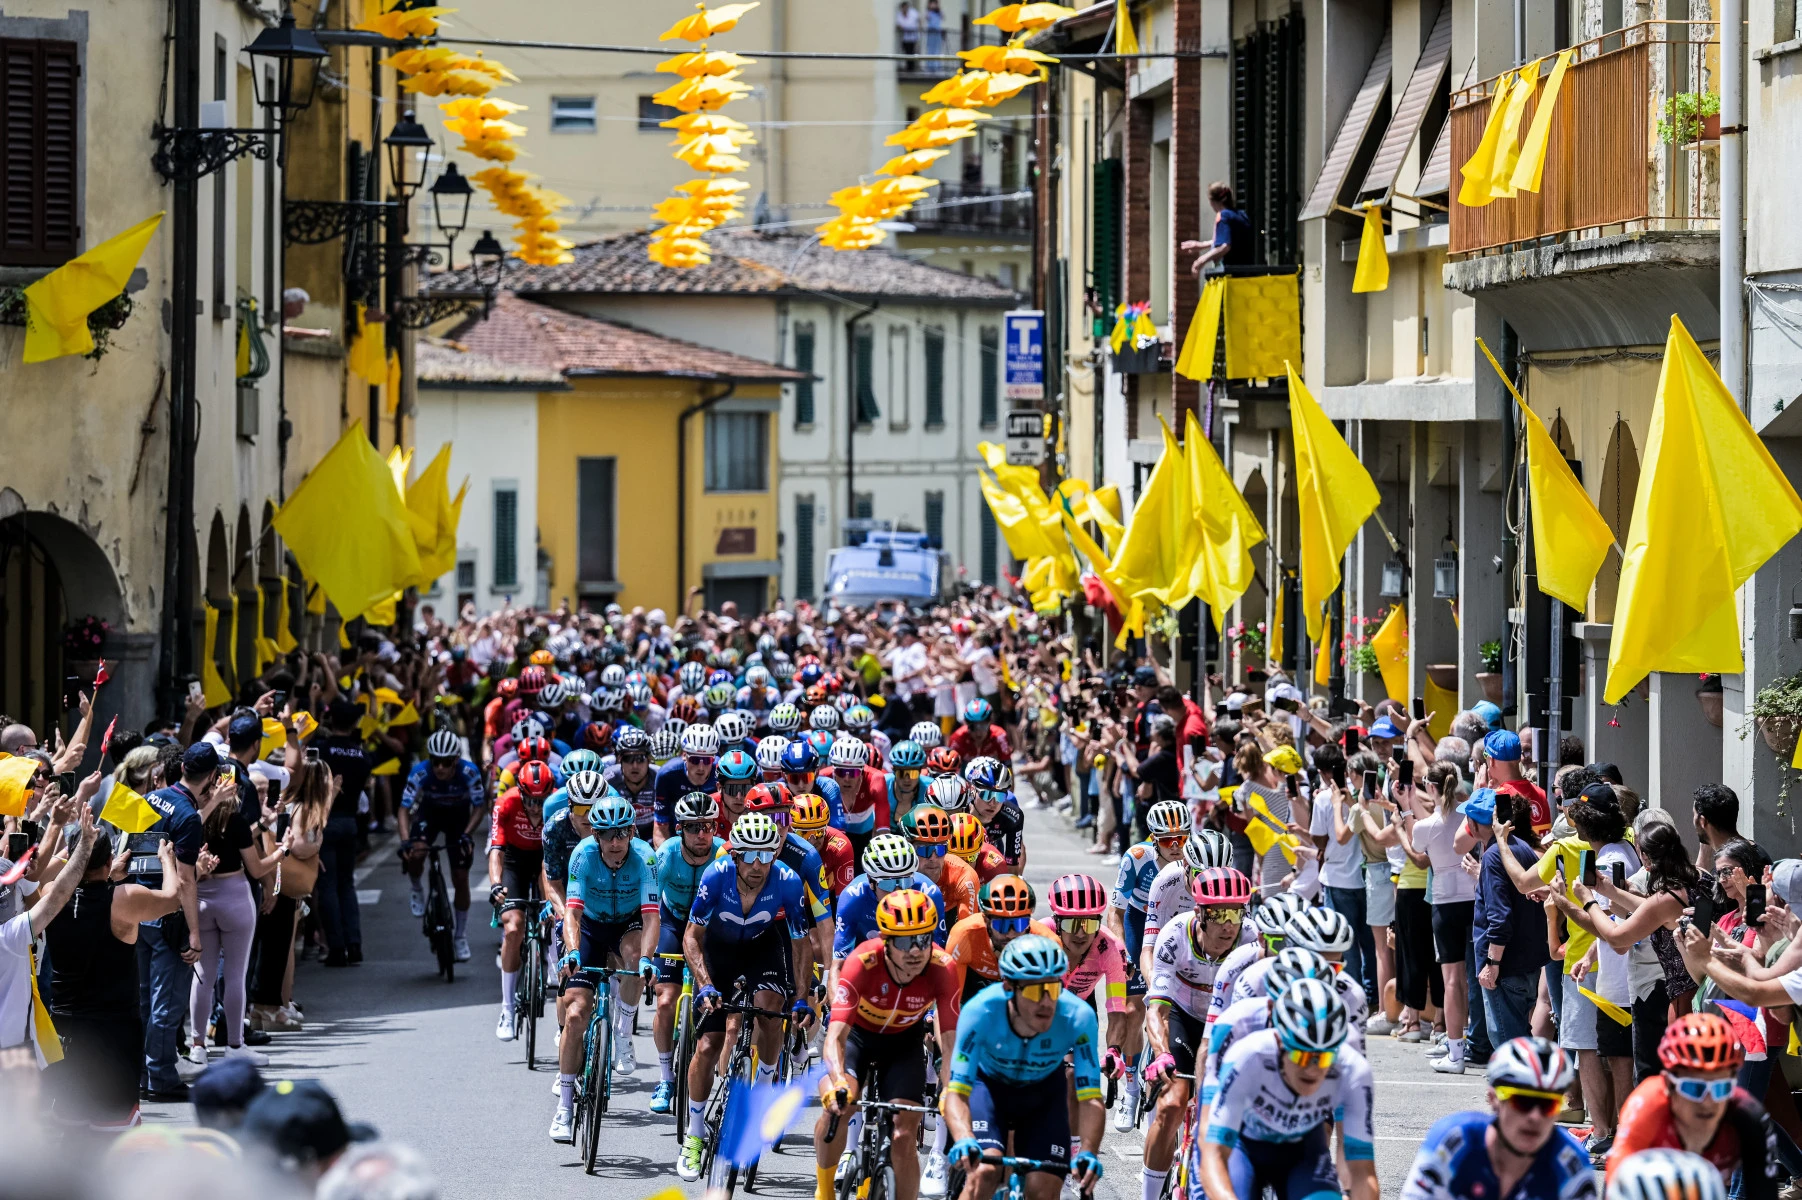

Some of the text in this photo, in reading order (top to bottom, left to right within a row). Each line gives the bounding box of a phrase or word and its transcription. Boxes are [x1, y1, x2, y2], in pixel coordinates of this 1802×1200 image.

[329, 746, 364, 758] POLIZIA
[147, 793, 175, 815] POLIZIA
[785, 842, 807, 858] TREK
[1014, 830, 1022, 855] BOSS
[833, 985, 850, 1005] R
[1253, 1095, 1333, 1125] BAHRAIN
